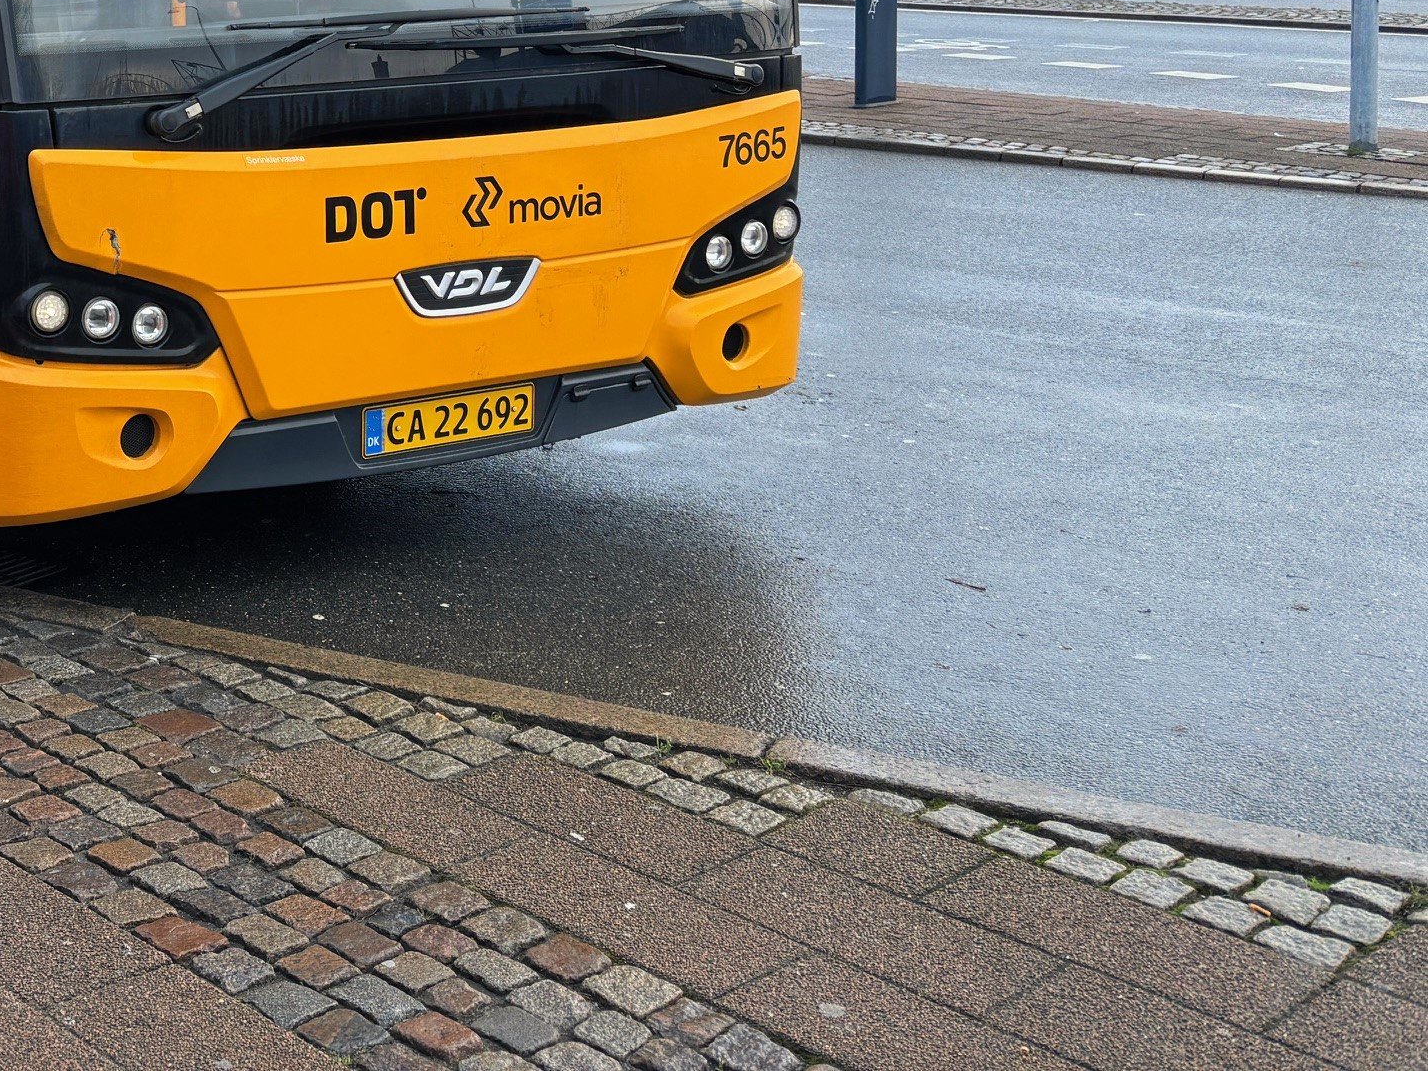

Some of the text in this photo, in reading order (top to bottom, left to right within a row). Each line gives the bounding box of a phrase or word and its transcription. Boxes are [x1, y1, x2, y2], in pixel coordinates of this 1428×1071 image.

[718, 126, 787, 168] 7665
[325, 187, 426, 244] DOT
[509, 184, 602, 224] movia
[420, 266, 512, 300] VDL
[367, 393, 529, 447] DK CA 22 692
